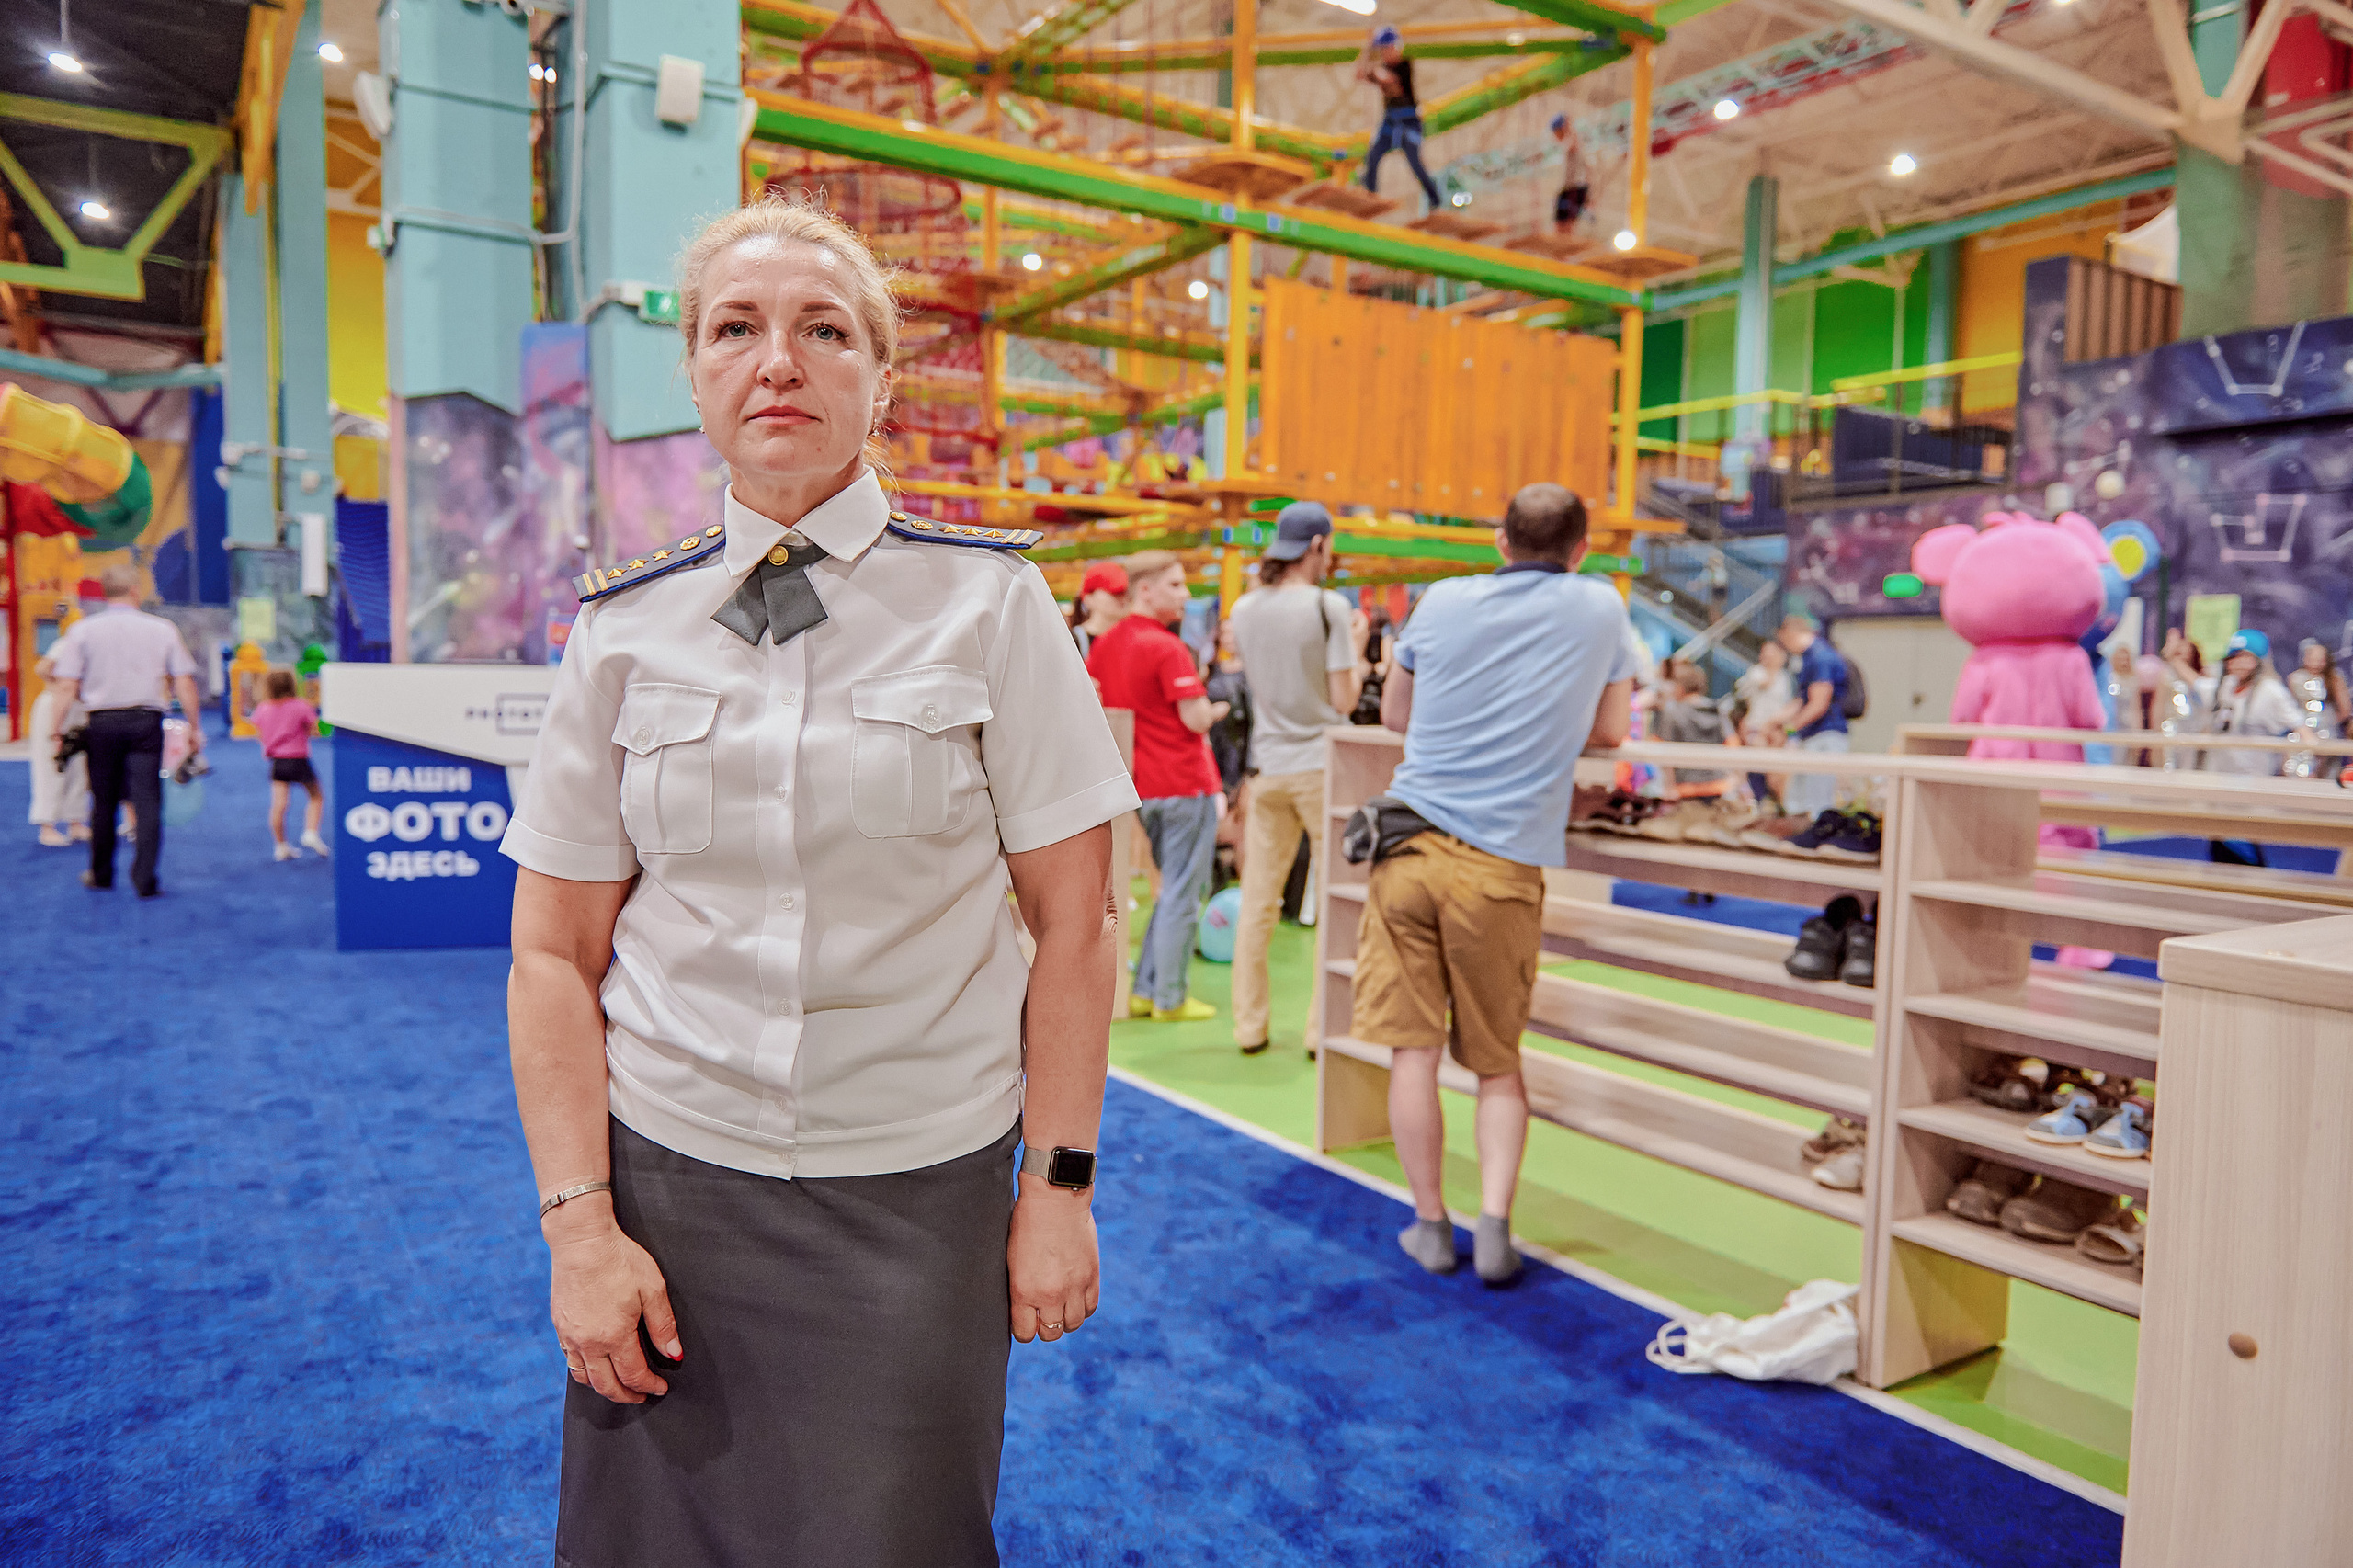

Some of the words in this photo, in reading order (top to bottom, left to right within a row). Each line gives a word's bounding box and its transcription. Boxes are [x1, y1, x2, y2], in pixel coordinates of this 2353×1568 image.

[369, 766, 471, 792] ВАШИ
[345, 801, 507, 842] ФОТО
[367, 850, 480, 881] ЗДЕСЬ
